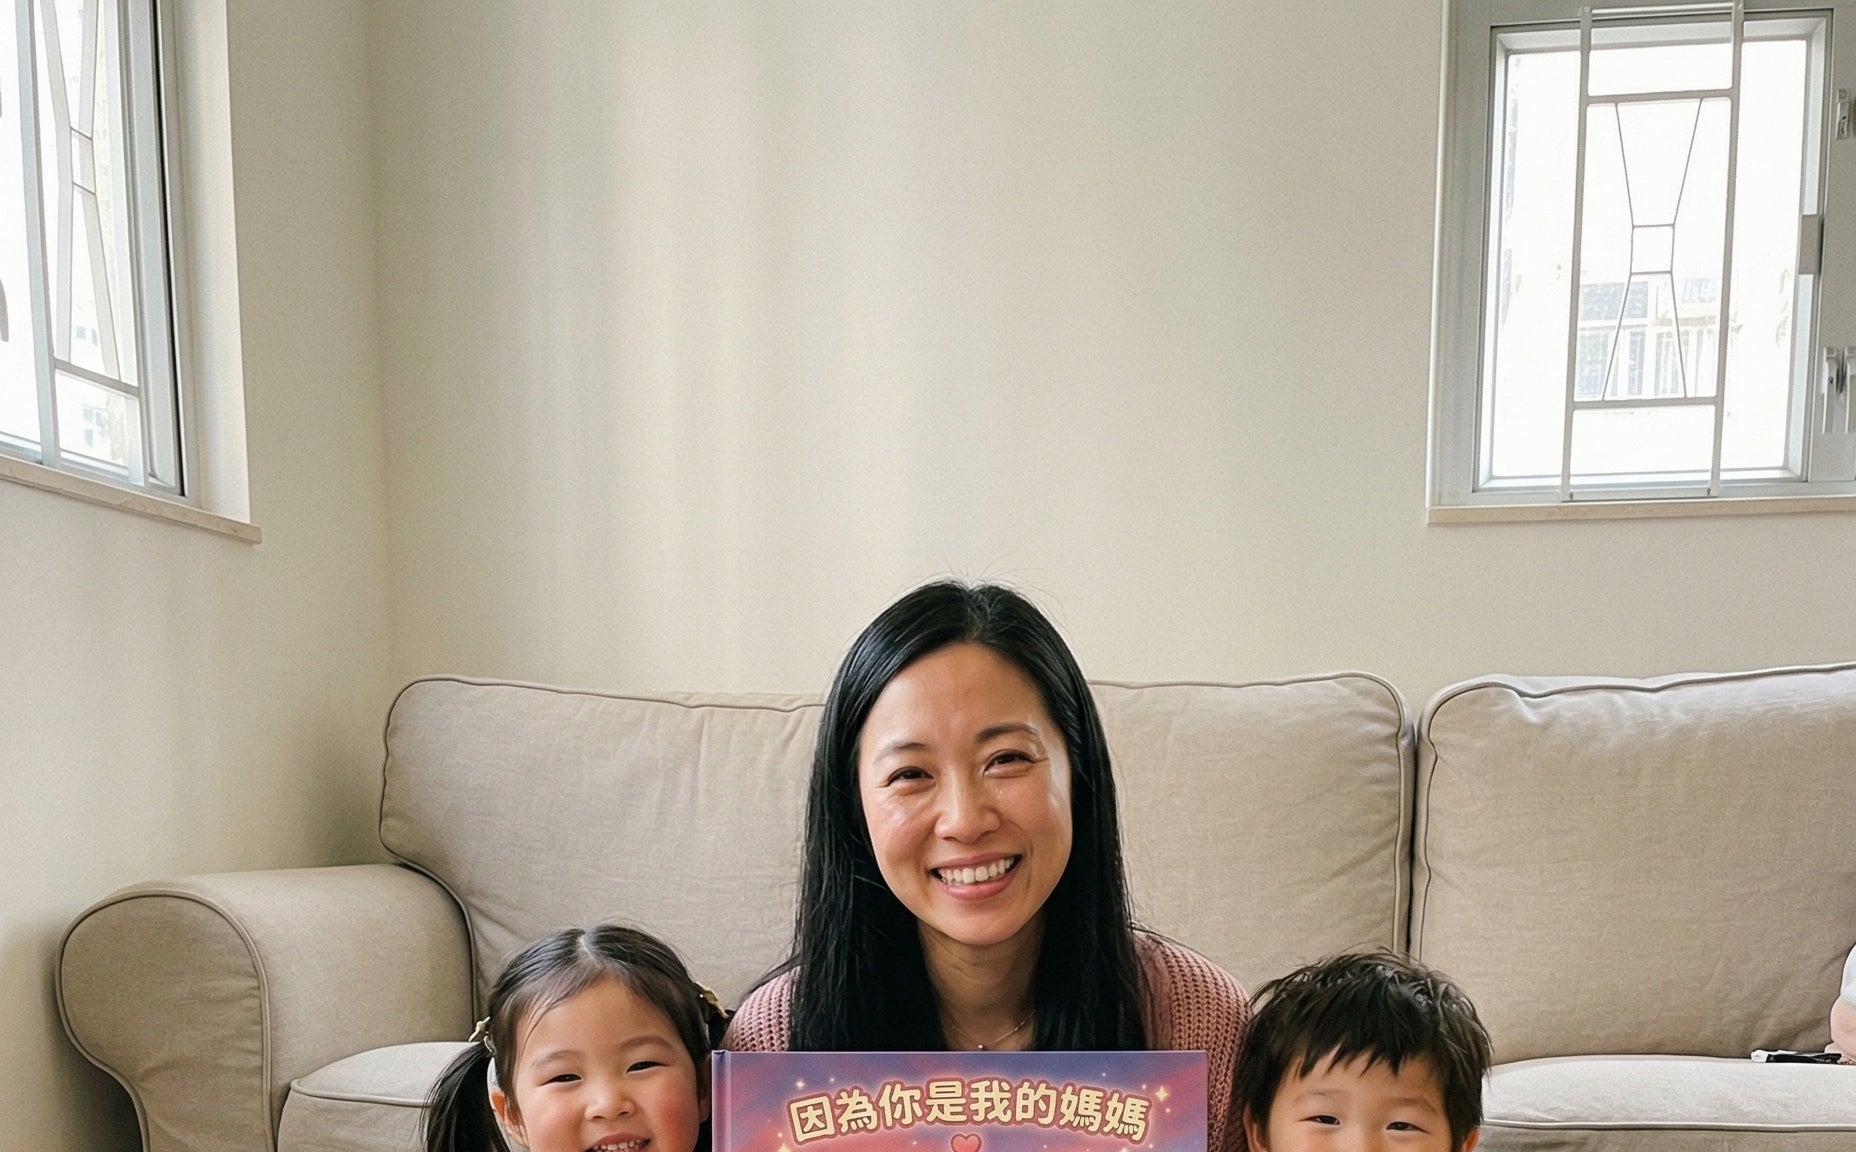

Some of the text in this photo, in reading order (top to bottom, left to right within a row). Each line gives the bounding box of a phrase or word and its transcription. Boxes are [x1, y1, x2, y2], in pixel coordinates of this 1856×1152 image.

[790, 1080, 1150, 1142] 因為你是我的媽媽
